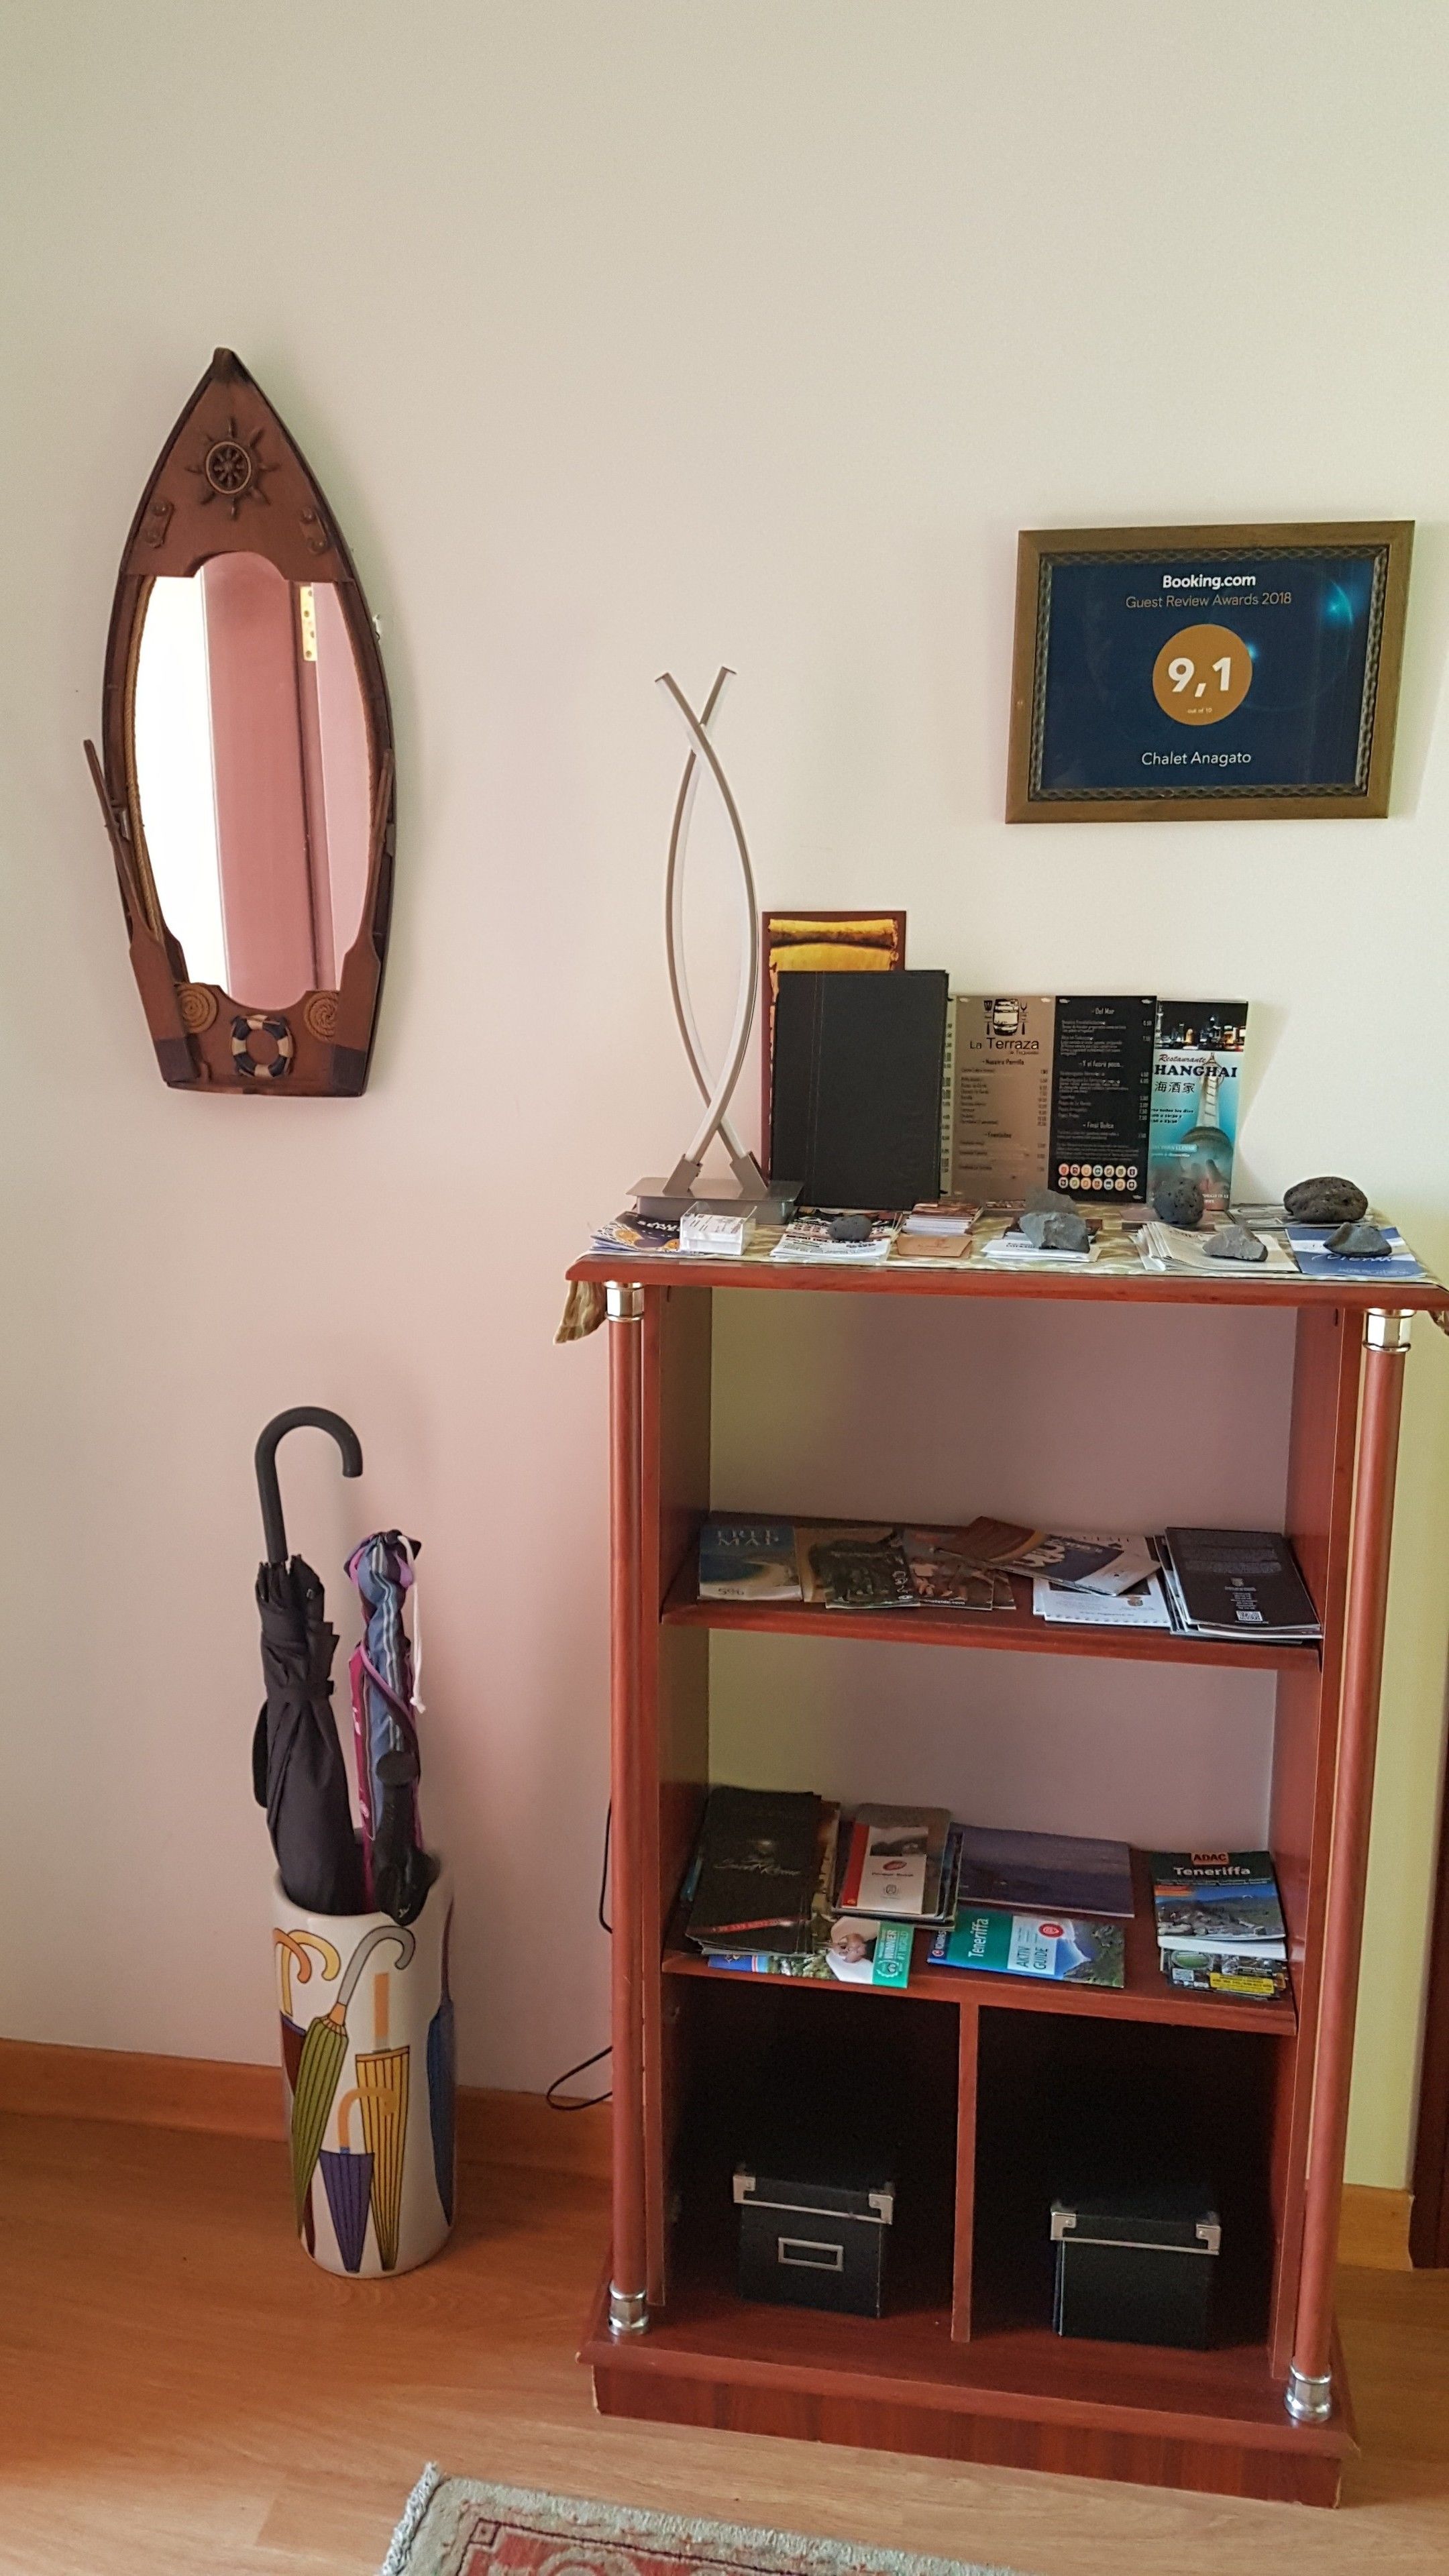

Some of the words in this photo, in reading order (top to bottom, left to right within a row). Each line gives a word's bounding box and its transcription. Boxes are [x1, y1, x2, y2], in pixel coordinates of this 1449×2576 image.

[1163, 574, 1256, 590] Booking.com
[1126, 596, 1163, 608] Guest
[1166, 595, 1210, 607] Review
[1212, 594, 1258, 606] Awards
[1261, 592, 1292, 604] 2018
[1168, 657, 1231, 698] 9,1
[1142, 751, 1187, 765] Chalet
[1191, 751, 1252, 767] Anagato
[969, 1040, 982, 1049] La
[986, 1037, 1040, 1050] Terraza
[1159, 1054, 1208, 1063] Restaurante
[1154, 1065, 1238, 1077] HANGHAI
[1155, 1081, 1195, 1093] 海酒家
[1193, 1854, 1227, 1862] ADAC
[1174, 1866, 1251, 1876] Teneriffa
[968, 1917, 989, 1957] Teneriffa
[1016, 1944, 1031, 1968] AKTIV
[1033, 1947, 1049, 1970] GUIDE
